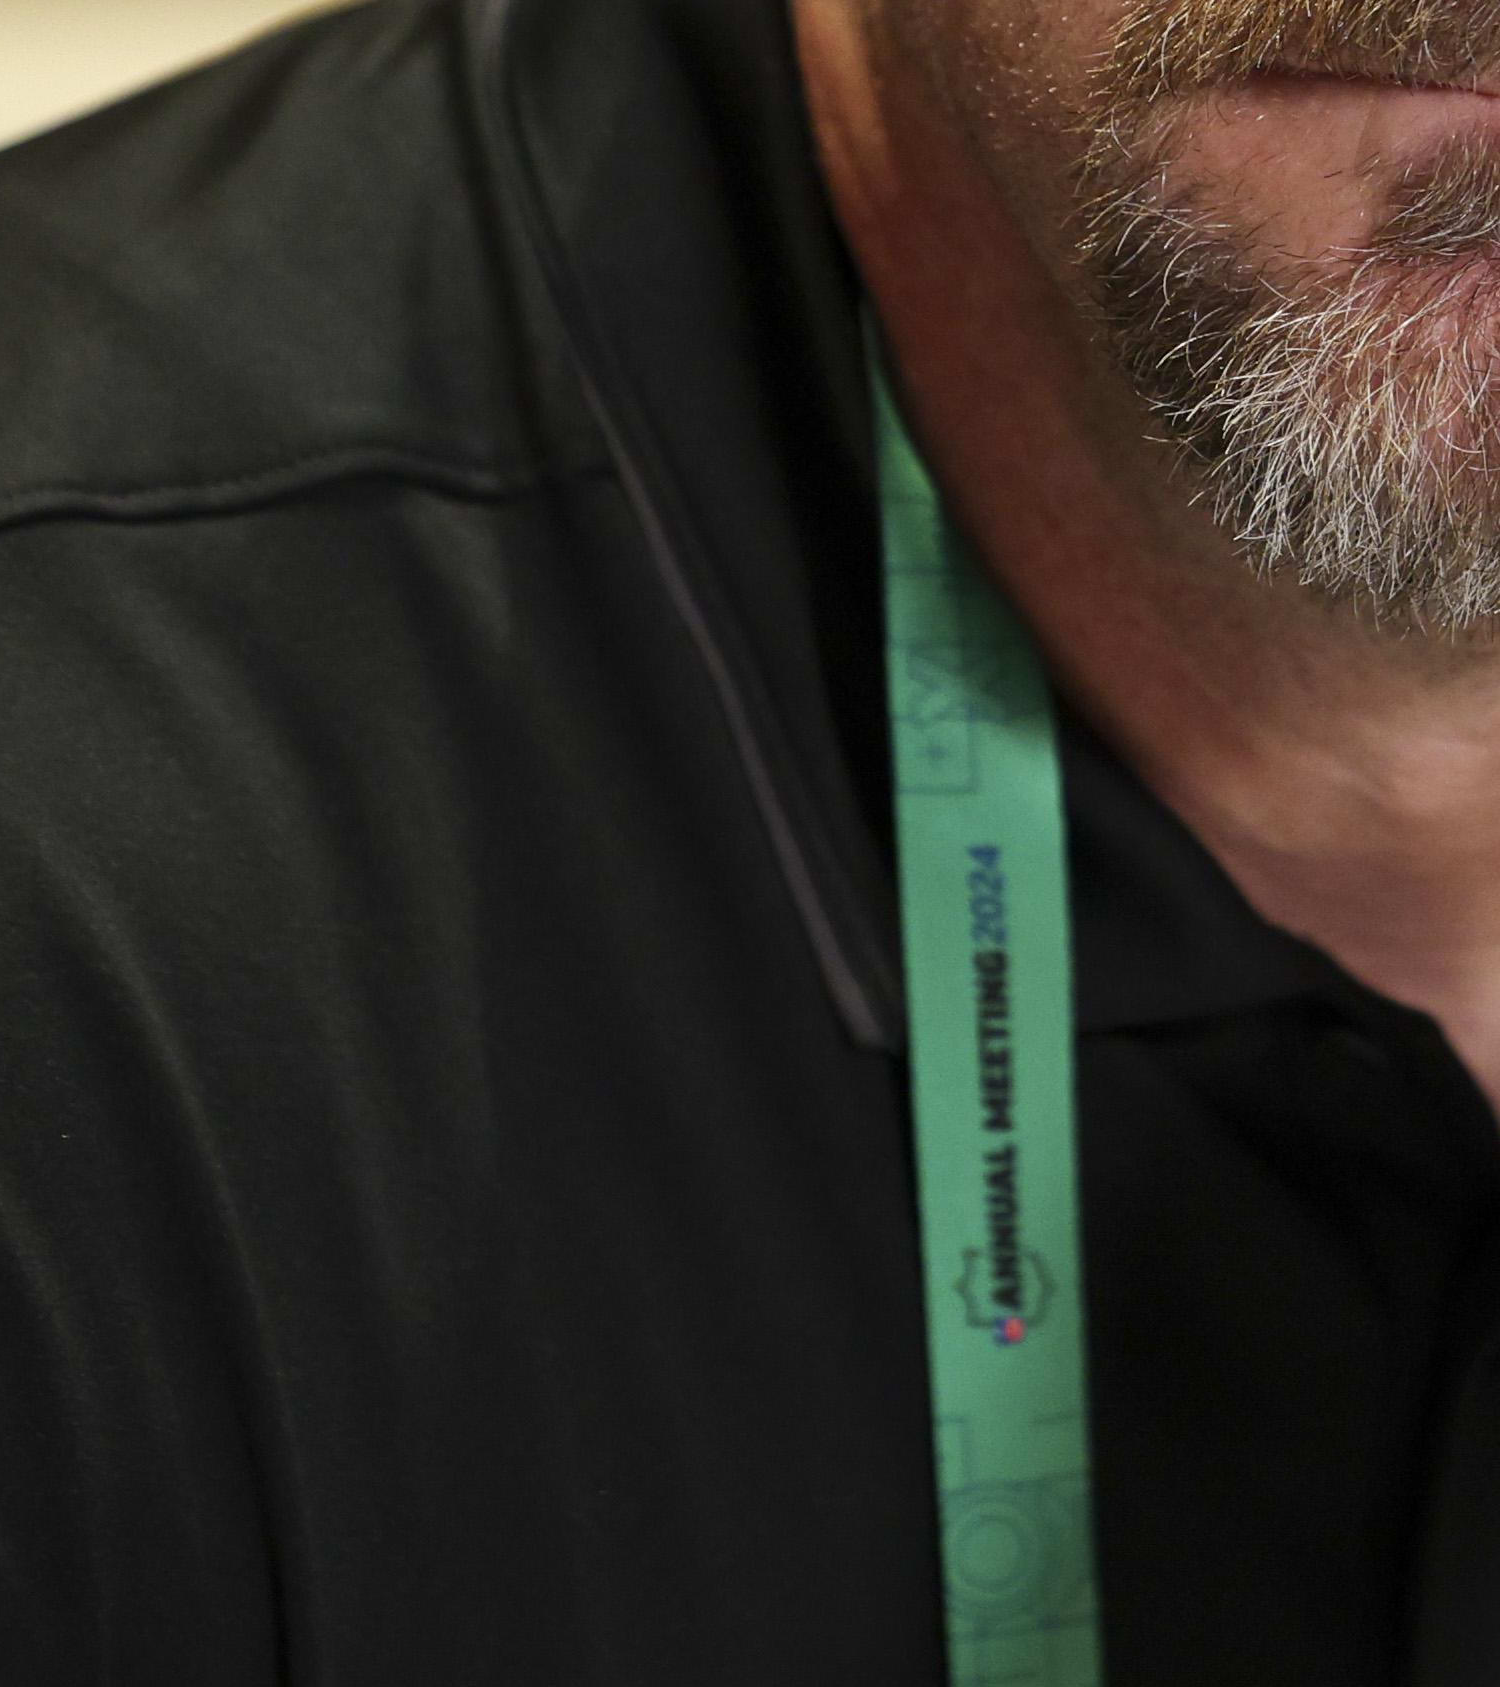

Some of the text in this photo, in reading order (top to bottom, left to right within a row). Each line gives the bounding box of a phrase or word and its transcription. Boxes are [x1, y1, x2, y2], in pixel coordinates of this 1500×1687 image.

[965, 842, 1022, 1310] ANNUAL MEETING 2024
